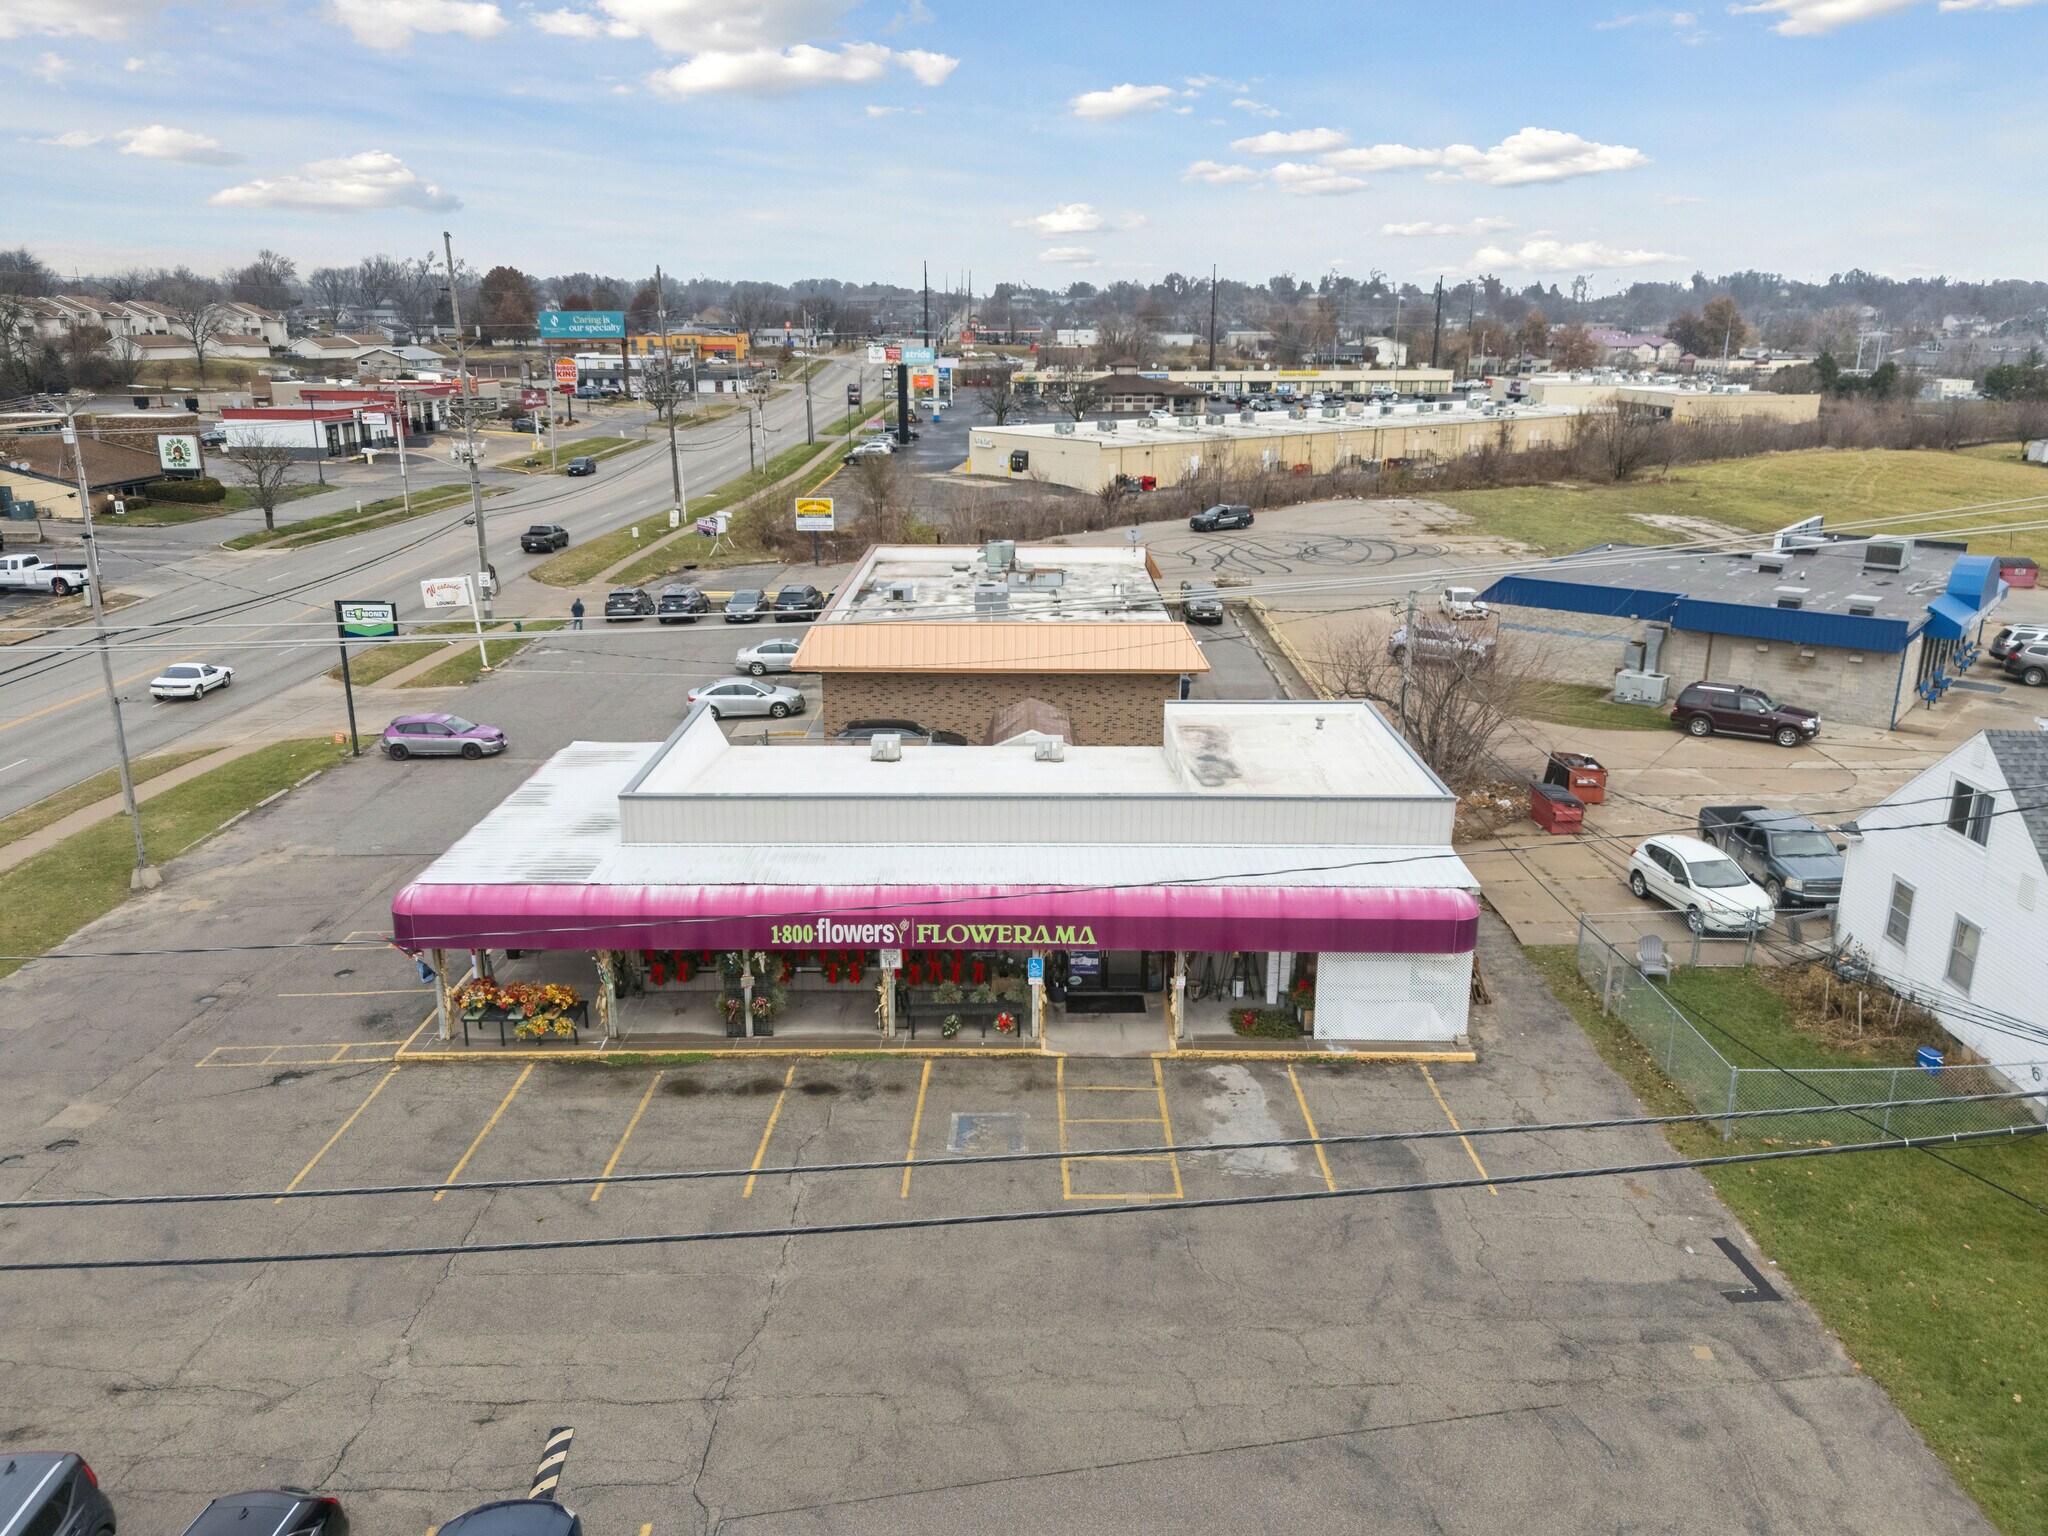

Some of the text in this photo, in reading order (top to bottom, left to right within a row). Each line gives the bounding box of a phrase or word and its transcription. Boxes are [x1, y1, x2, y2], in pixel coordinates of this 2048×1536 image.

[573, 315, 610, 325] Caring is
[585, 323, 621, 333] specialty
[905, 350, 931, 358] stride
[362, 610, 389, 618] MONEY
[916, 924, 1097, 945] FLOWERAMA
